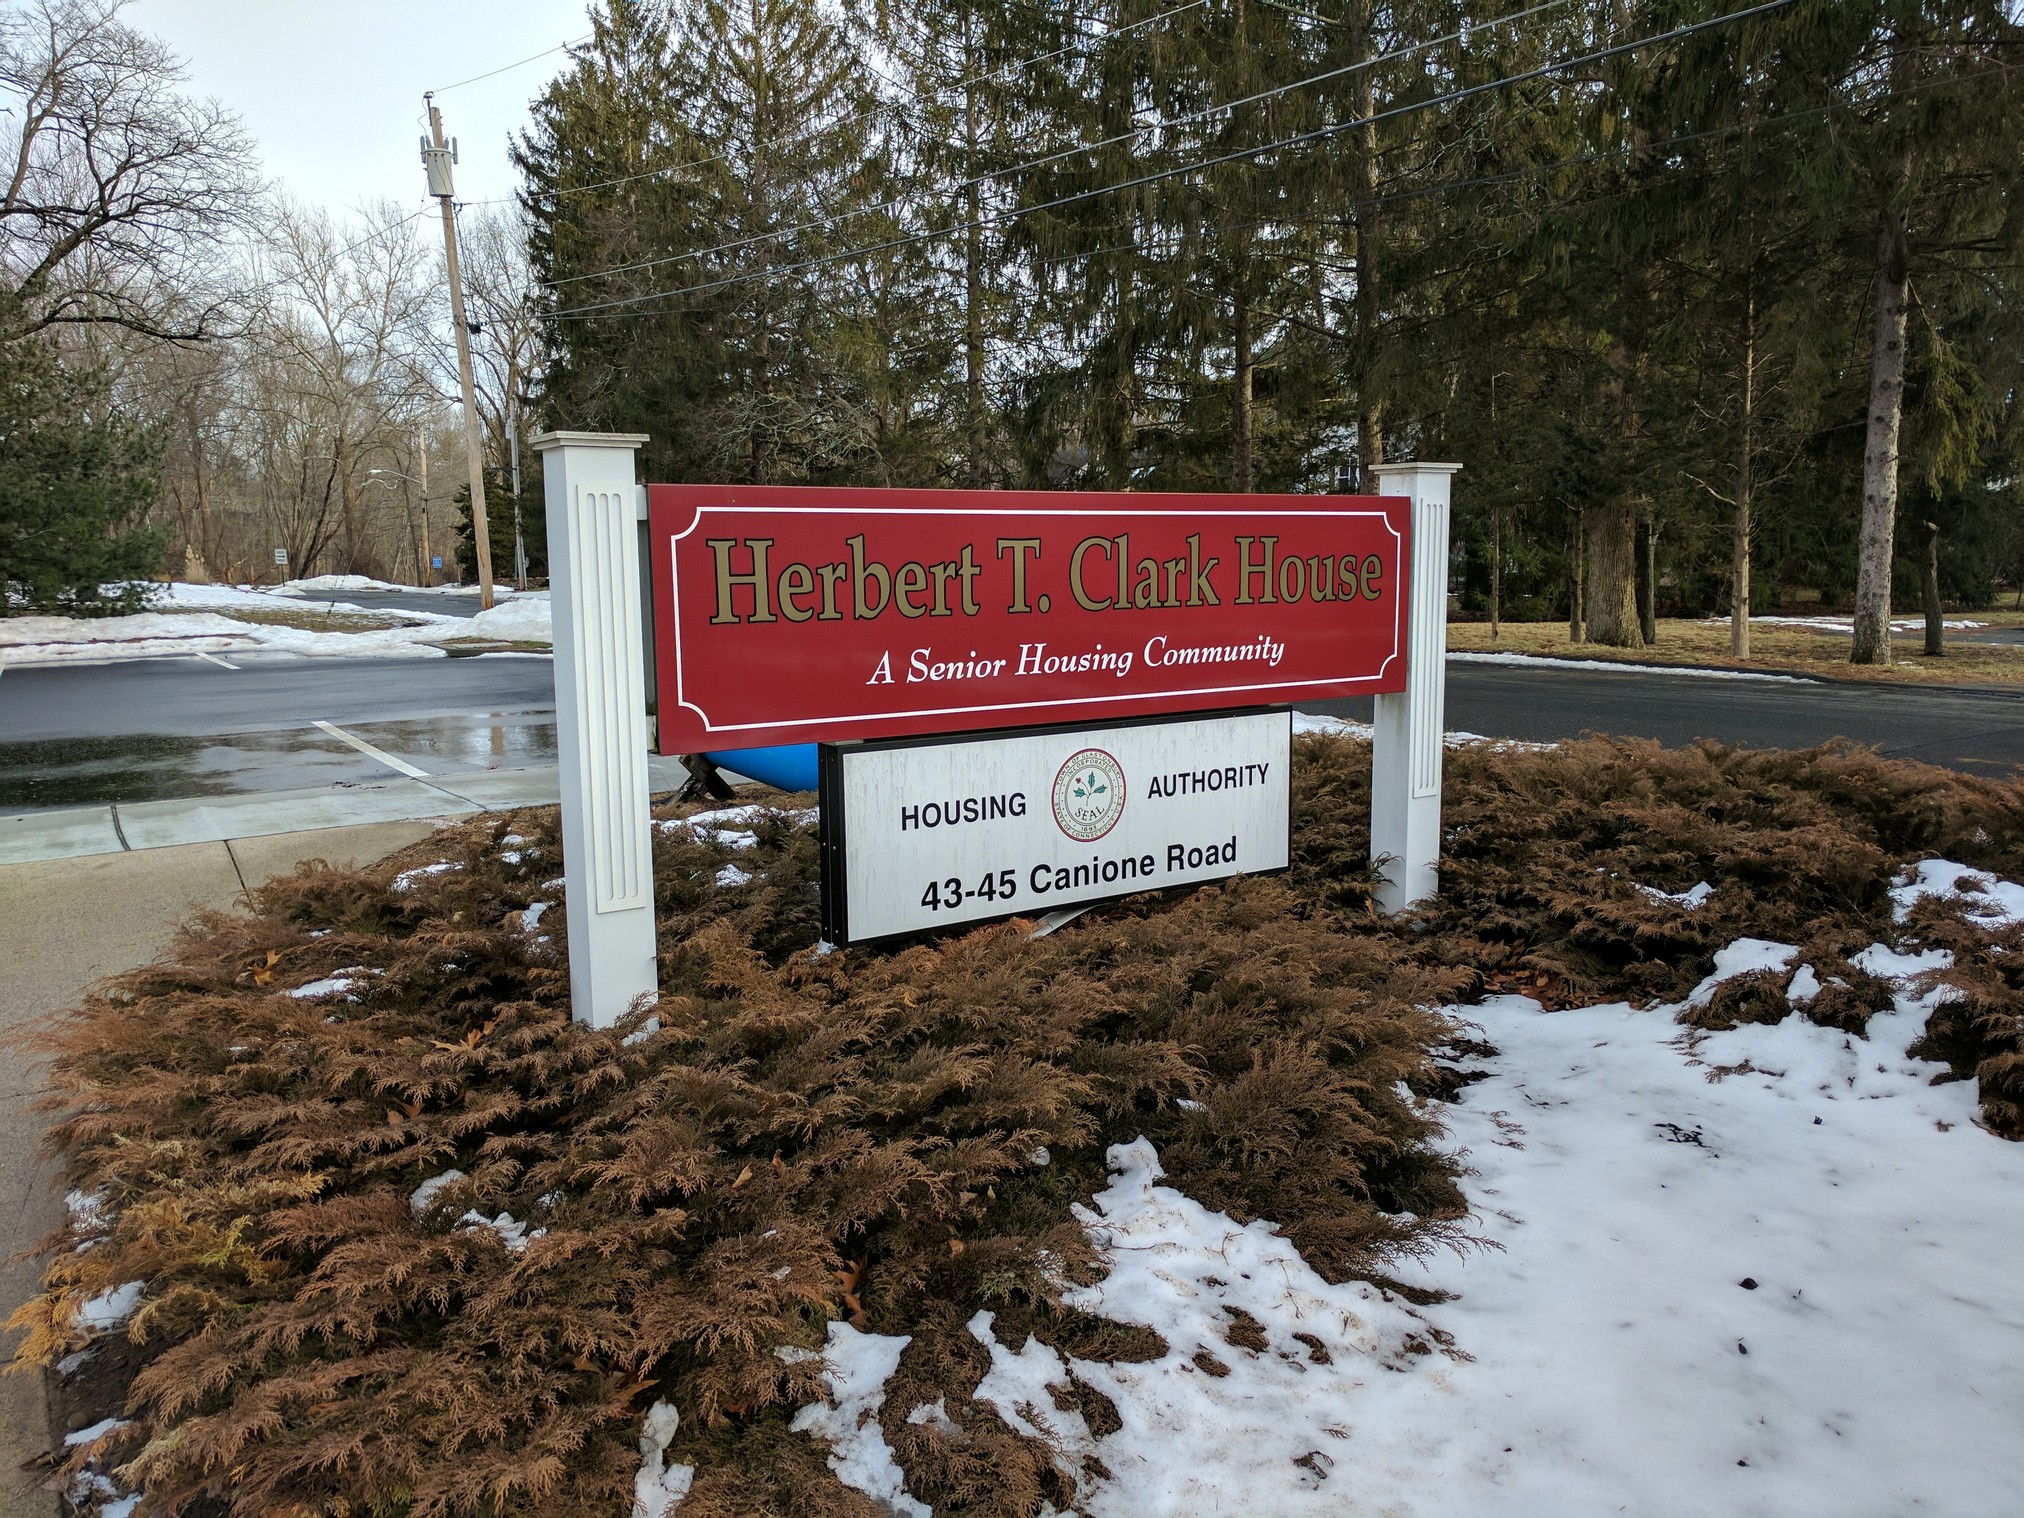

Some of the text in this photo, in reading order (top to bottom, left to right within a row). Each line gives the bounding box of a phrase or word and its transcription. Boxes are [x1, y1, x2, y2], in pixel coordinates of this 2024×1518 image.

[705, 532, 1383, 625] Herbert T. Clark House
[866, 635, 1285, 685] A Senior Housing Community
[1057, 765, 1070, 785] TOWN
[1082, 752, 1122, 780] GLASTONBURY
[1067, 759, 1112, 777] INCORPORATED
[1147, 763, 1270, 800] AUTHORITY
[901, 792, 1027, 831] HOUSING
[1072, 816, 1115, 839] CONNECTICUT
[1074, 806, 1105, 821] SEAL
[921, 835, 1238, 911] 43-45 Canione Road
